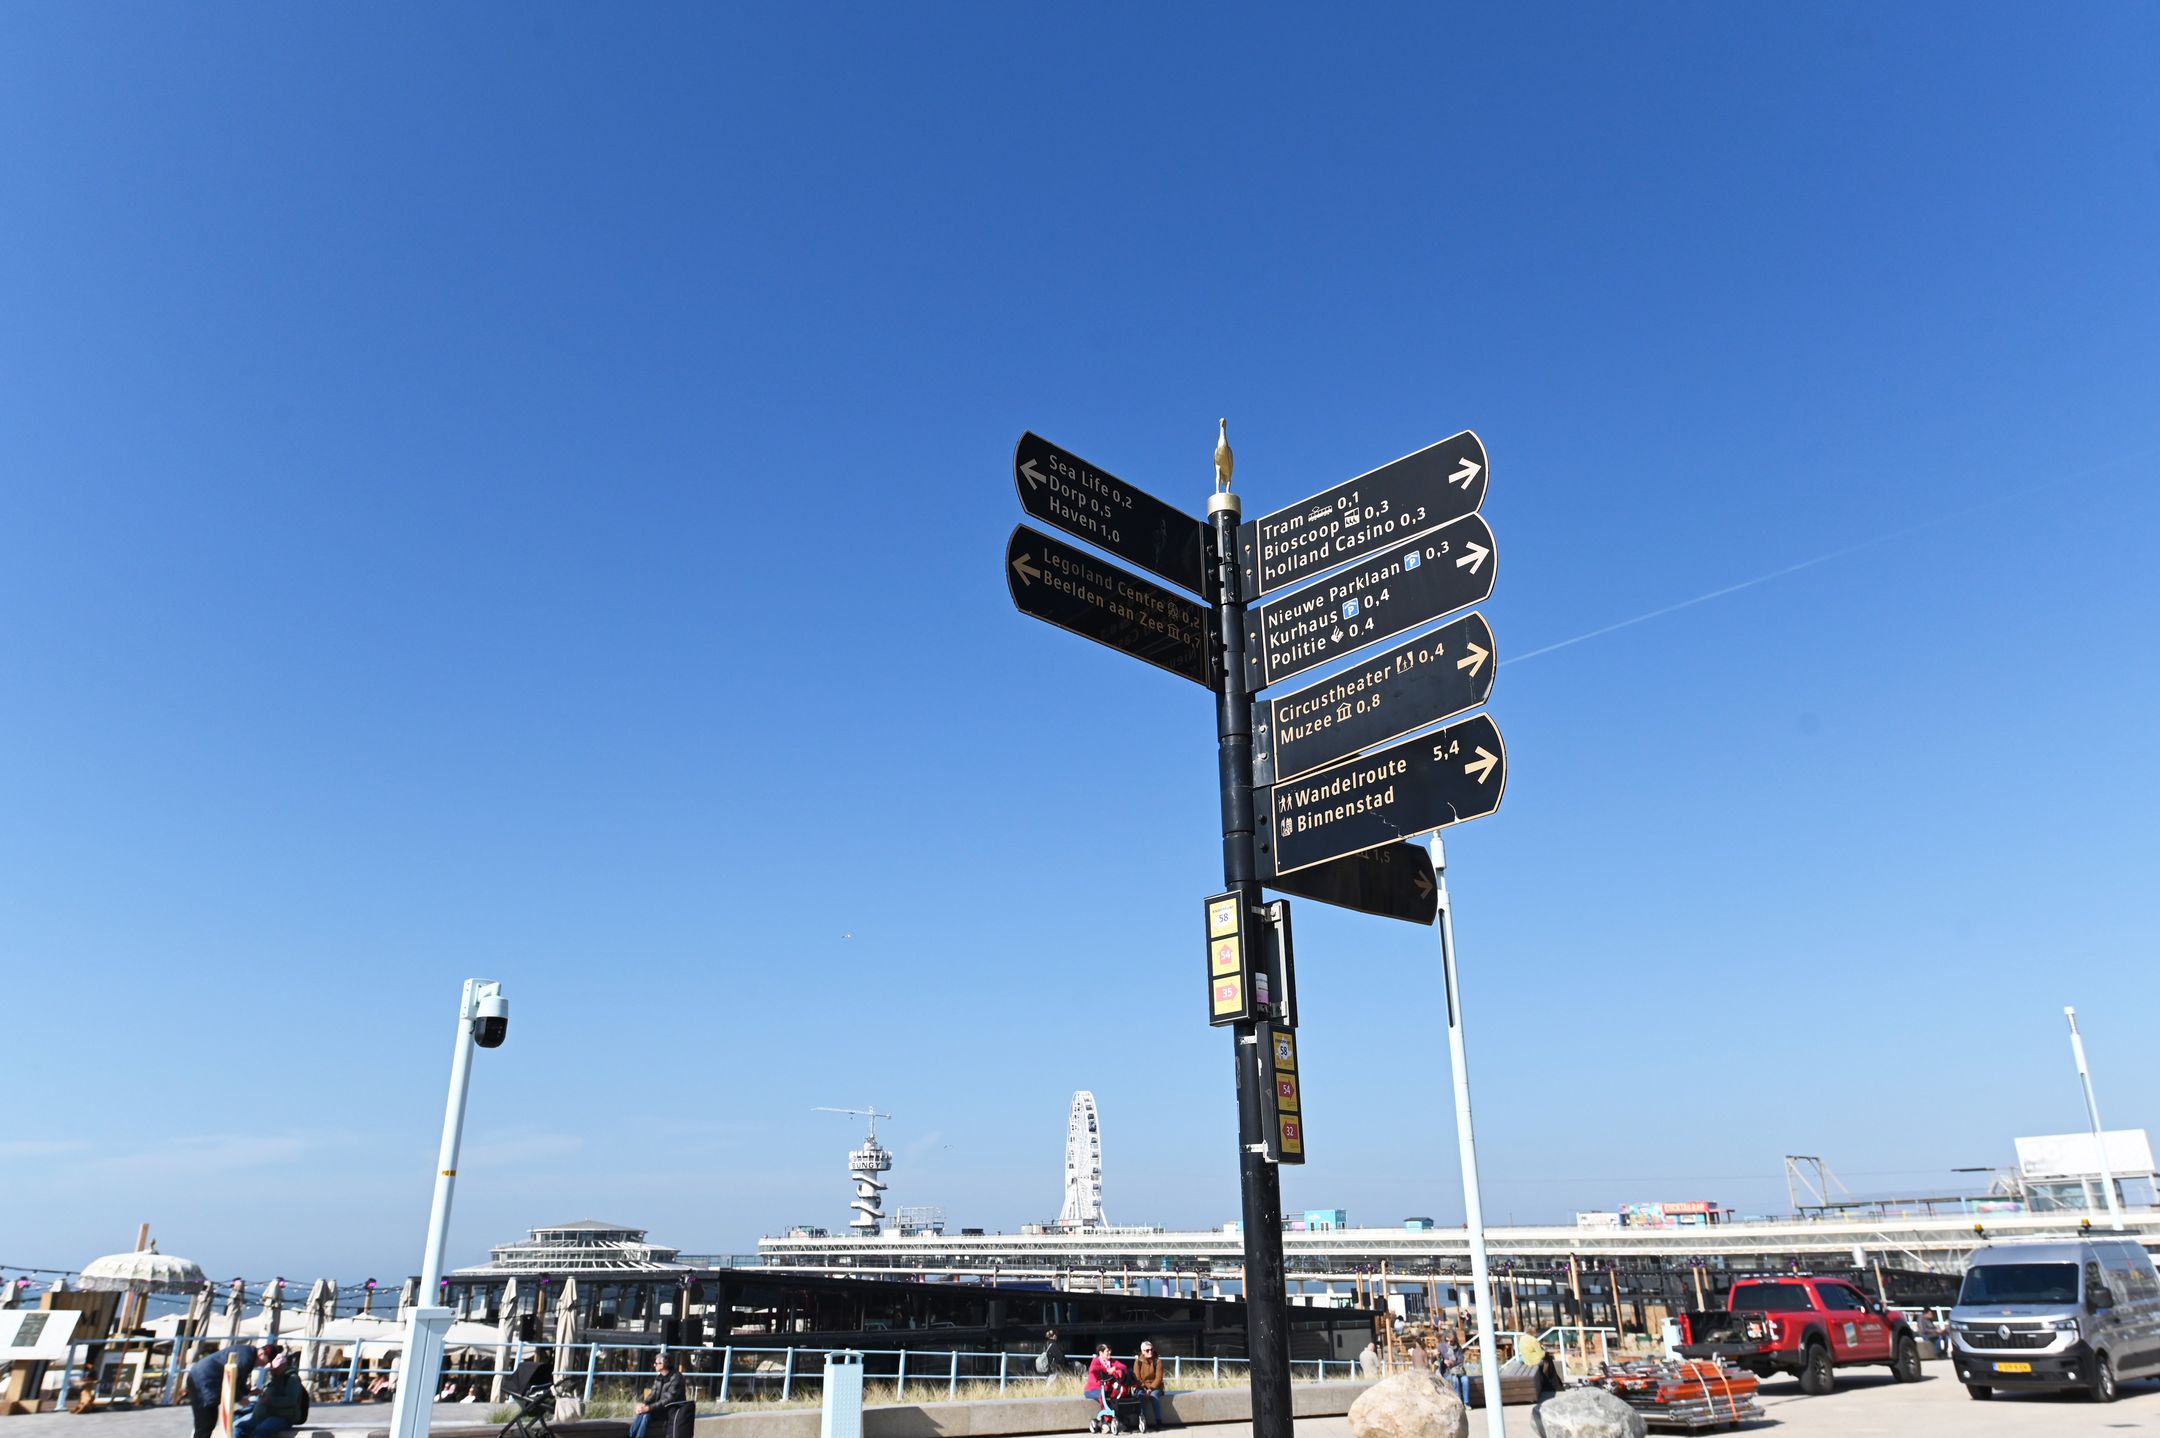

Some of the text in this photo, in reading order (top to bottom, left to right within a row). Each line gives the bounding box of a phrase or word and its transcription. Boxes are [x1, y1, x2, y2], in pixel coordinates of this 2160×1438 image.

[1049, 454, 1133, 509] Sea Life 0,2
[1049, 476, 1112, 518] Dorp 0,5
[1049, 496, 1120, 543] Haven 1,0
[1263, 491, 1360, 541] Tram 0,1
[1264, 500, 1389, 561] Bioscoop 0,3
[1265, 507, 1427, 581] holland Casino 0,3
[1043, 547, 1200, 629] Legoland Centre 0,2
[1043, 570, 1201, 649] Beelden aan Zee 0,7
[1268, 595, 1324, 629] Nieuwe
[1329, 561, 1400, 602] Parklaan
[1425, 541, 1450, 560] 0,3
[1269, 609, 1339, 649] Kurhaus
[1364, 588, 1390, 609] 0,4
[1271, 617, 1375, 670] Politie 0,4
[1279, 642, 1445, 724] Circustheater 0,4
[1280, 693, 1381, 745] Muzee 0,8
[1295, 740, 1460, 809] Wandelroute 5,4
[1297, 786, 1395, 833] Binnenstad
[1218, 912, 1229, 923] 58
[1220, 949, 1231, 960] 54
[1222, 987, 1233, 998] 35
[1280, 1045, 1288, 1057] 58
[1282, 1084, 1291, 1097] 54
[1286, 1126, 1294, 1137] 32
